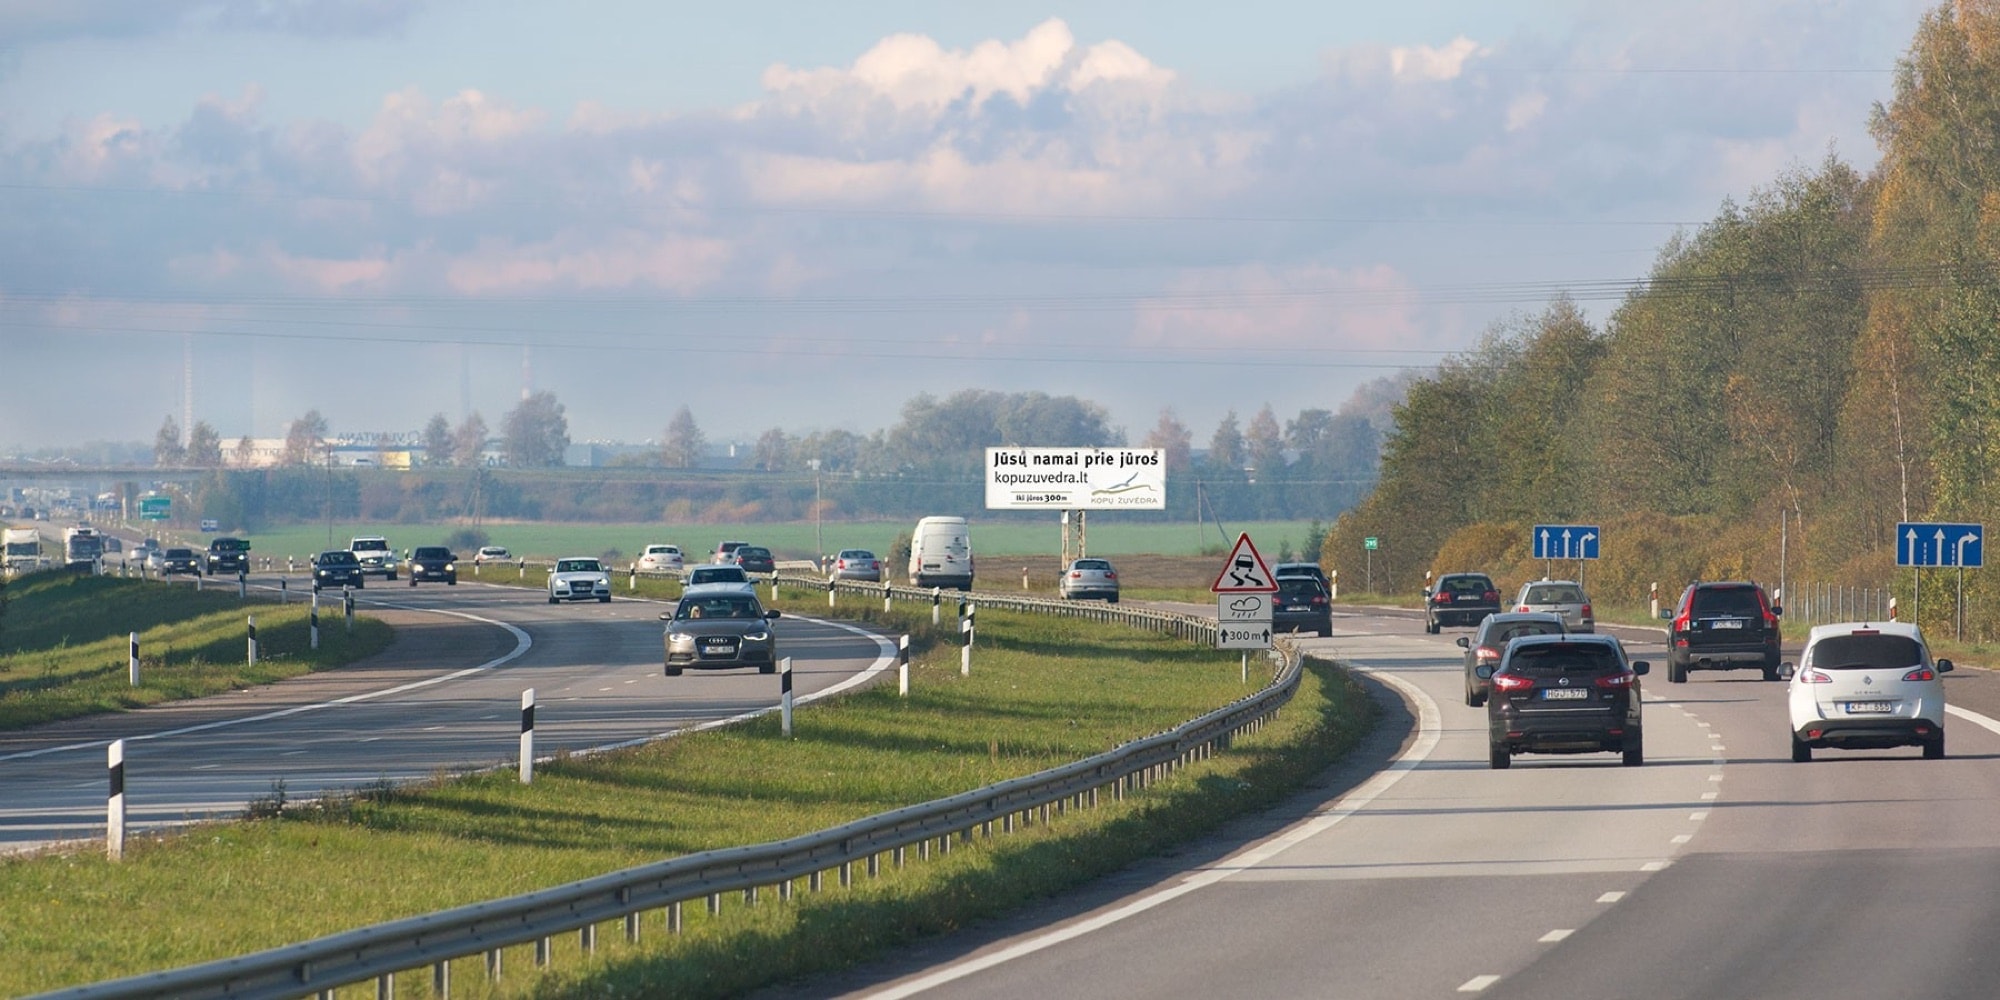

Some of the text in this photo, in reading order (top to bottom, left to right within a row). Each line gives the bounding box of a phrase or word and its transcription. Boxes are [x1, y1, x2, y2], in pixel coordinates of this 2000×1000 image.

[994, 452, 1158, 468] Jūsų namai prie jūros
[994, 471, 1089, 486] kopuzuvedra.lt
[1229, 630, 1261, 640] 300 m
[1548, 689, 1565, 698] HGJ
